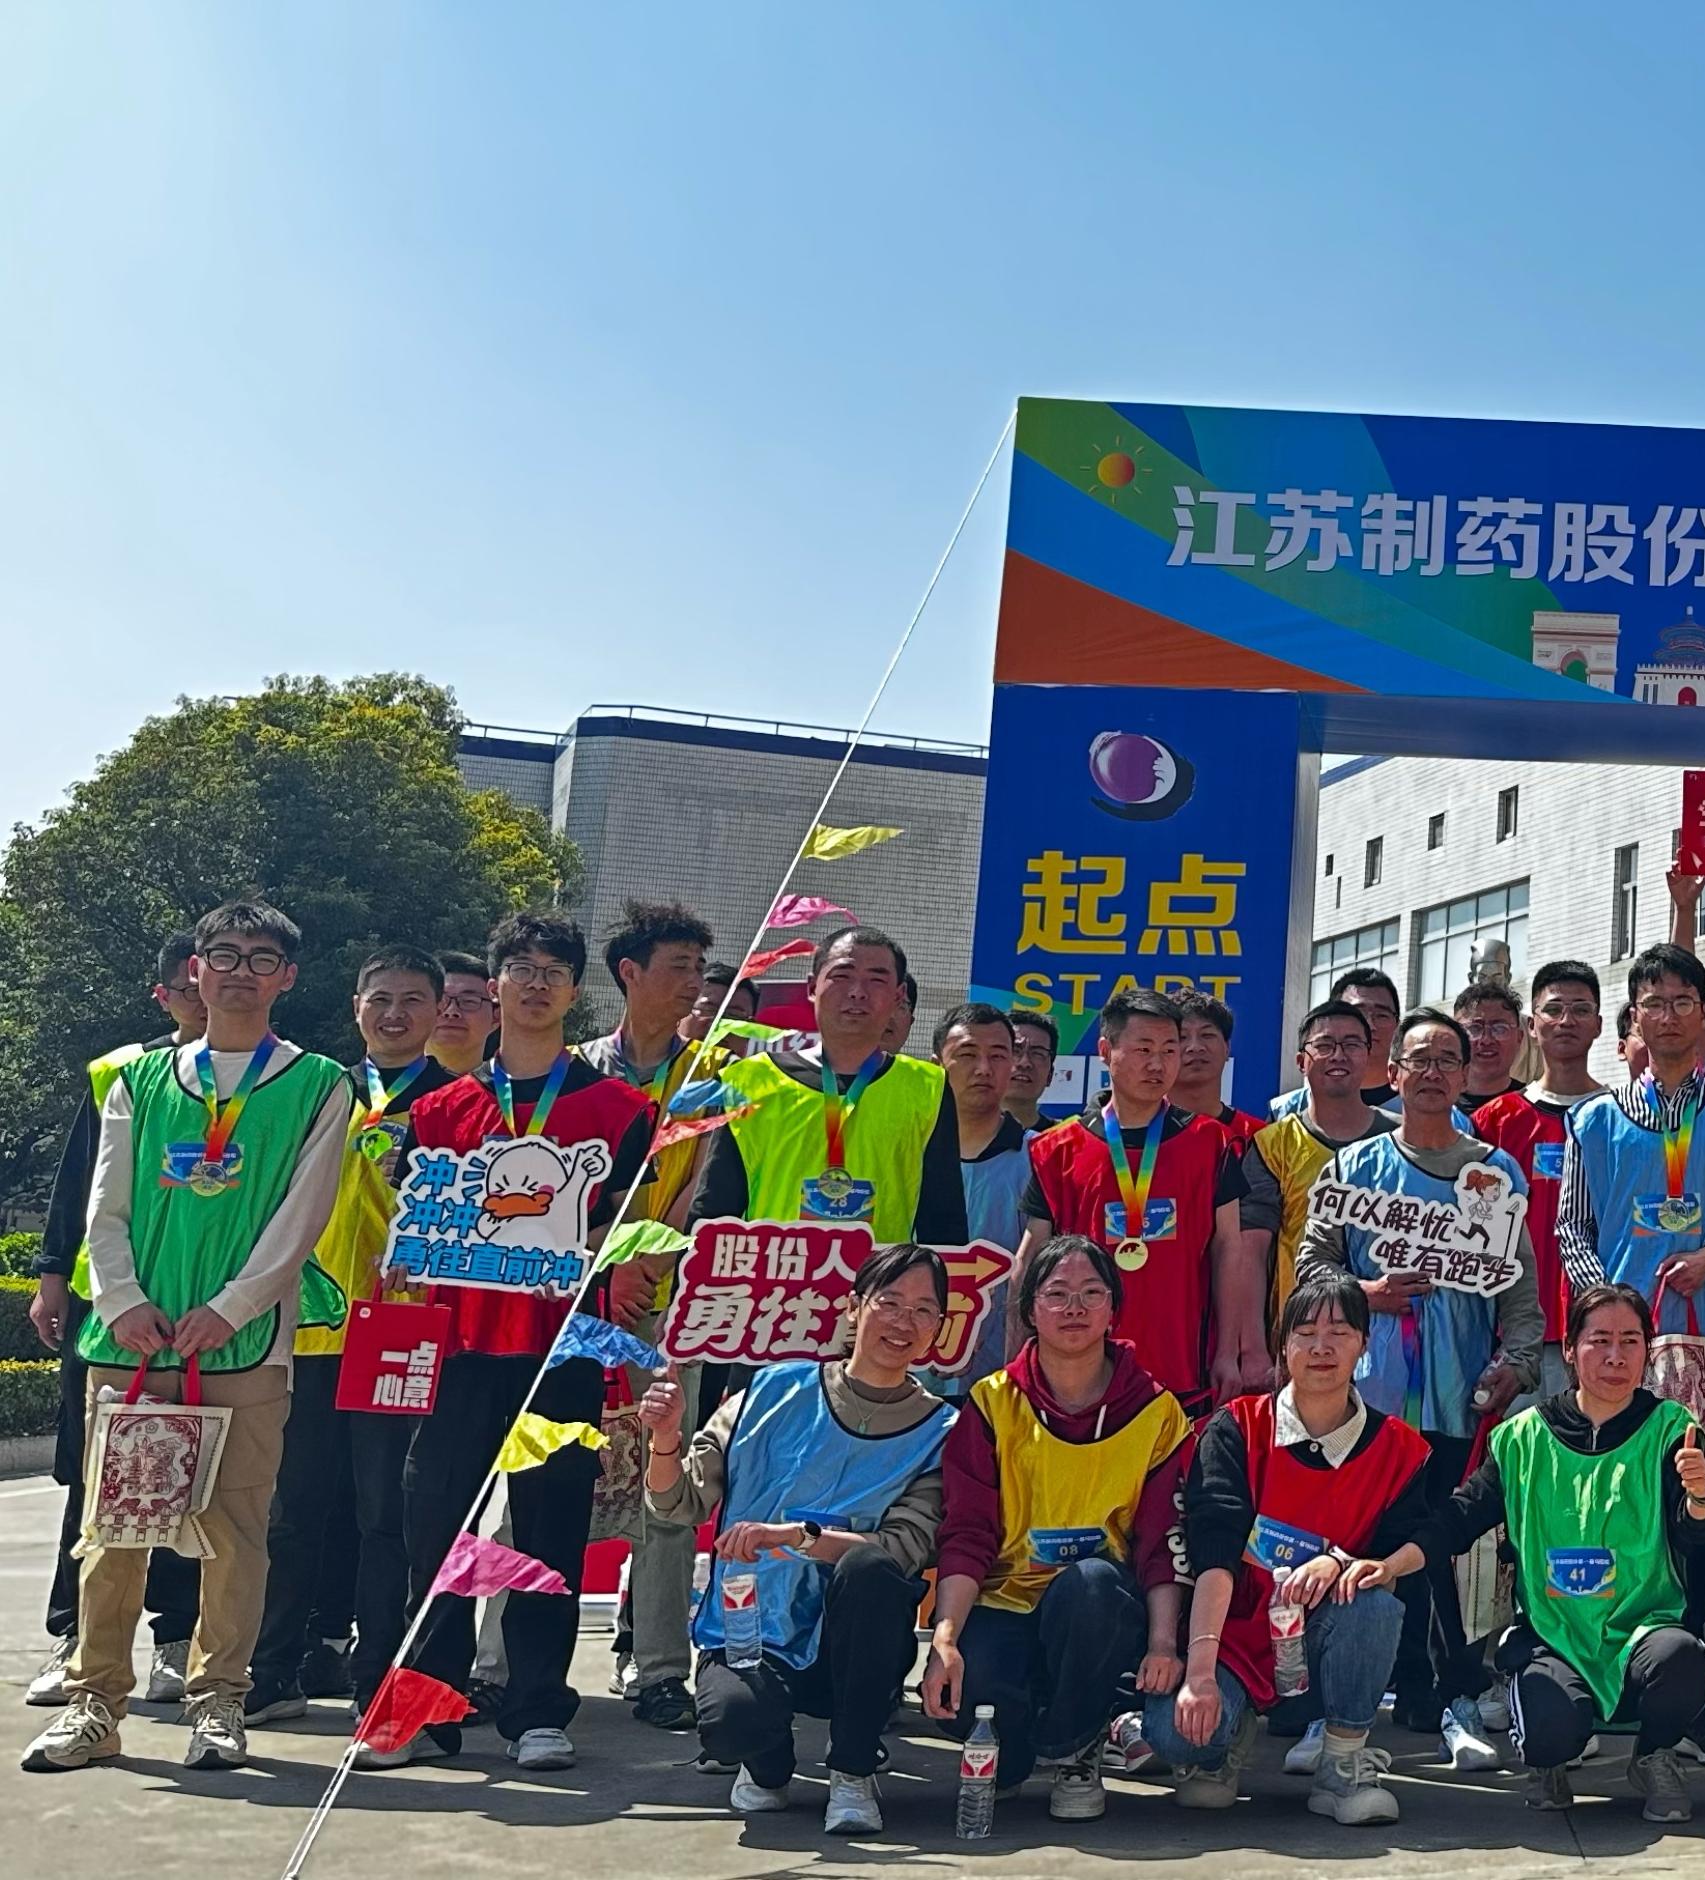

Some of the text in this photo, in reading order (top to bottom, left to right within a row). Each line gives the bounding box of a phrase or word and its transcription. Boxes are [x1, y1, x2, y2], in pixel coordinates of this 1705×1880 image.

[1017, 850, 1246, 956] 起点
[408, 1153, 457, 1195] 冲
[396, 1195, 484, 1238] 冲冲
[1314, 1184, 1456, 1243] 何以解忧
[390, 1235, 584, 1289] 勇往直前冲
[711, 1233, 857, 1281] 股份人
[1375, 1238, 1515, 1291] 唯有跑步
[380, 1341, 438, 1375] 一点
[372, 1373, 432, 1409] 心意
[1059, 1545, 1078, 1557] 08
[1275, 1543, 1295, 1561] 06
[1569, 1567, 1586, 1582] 41
